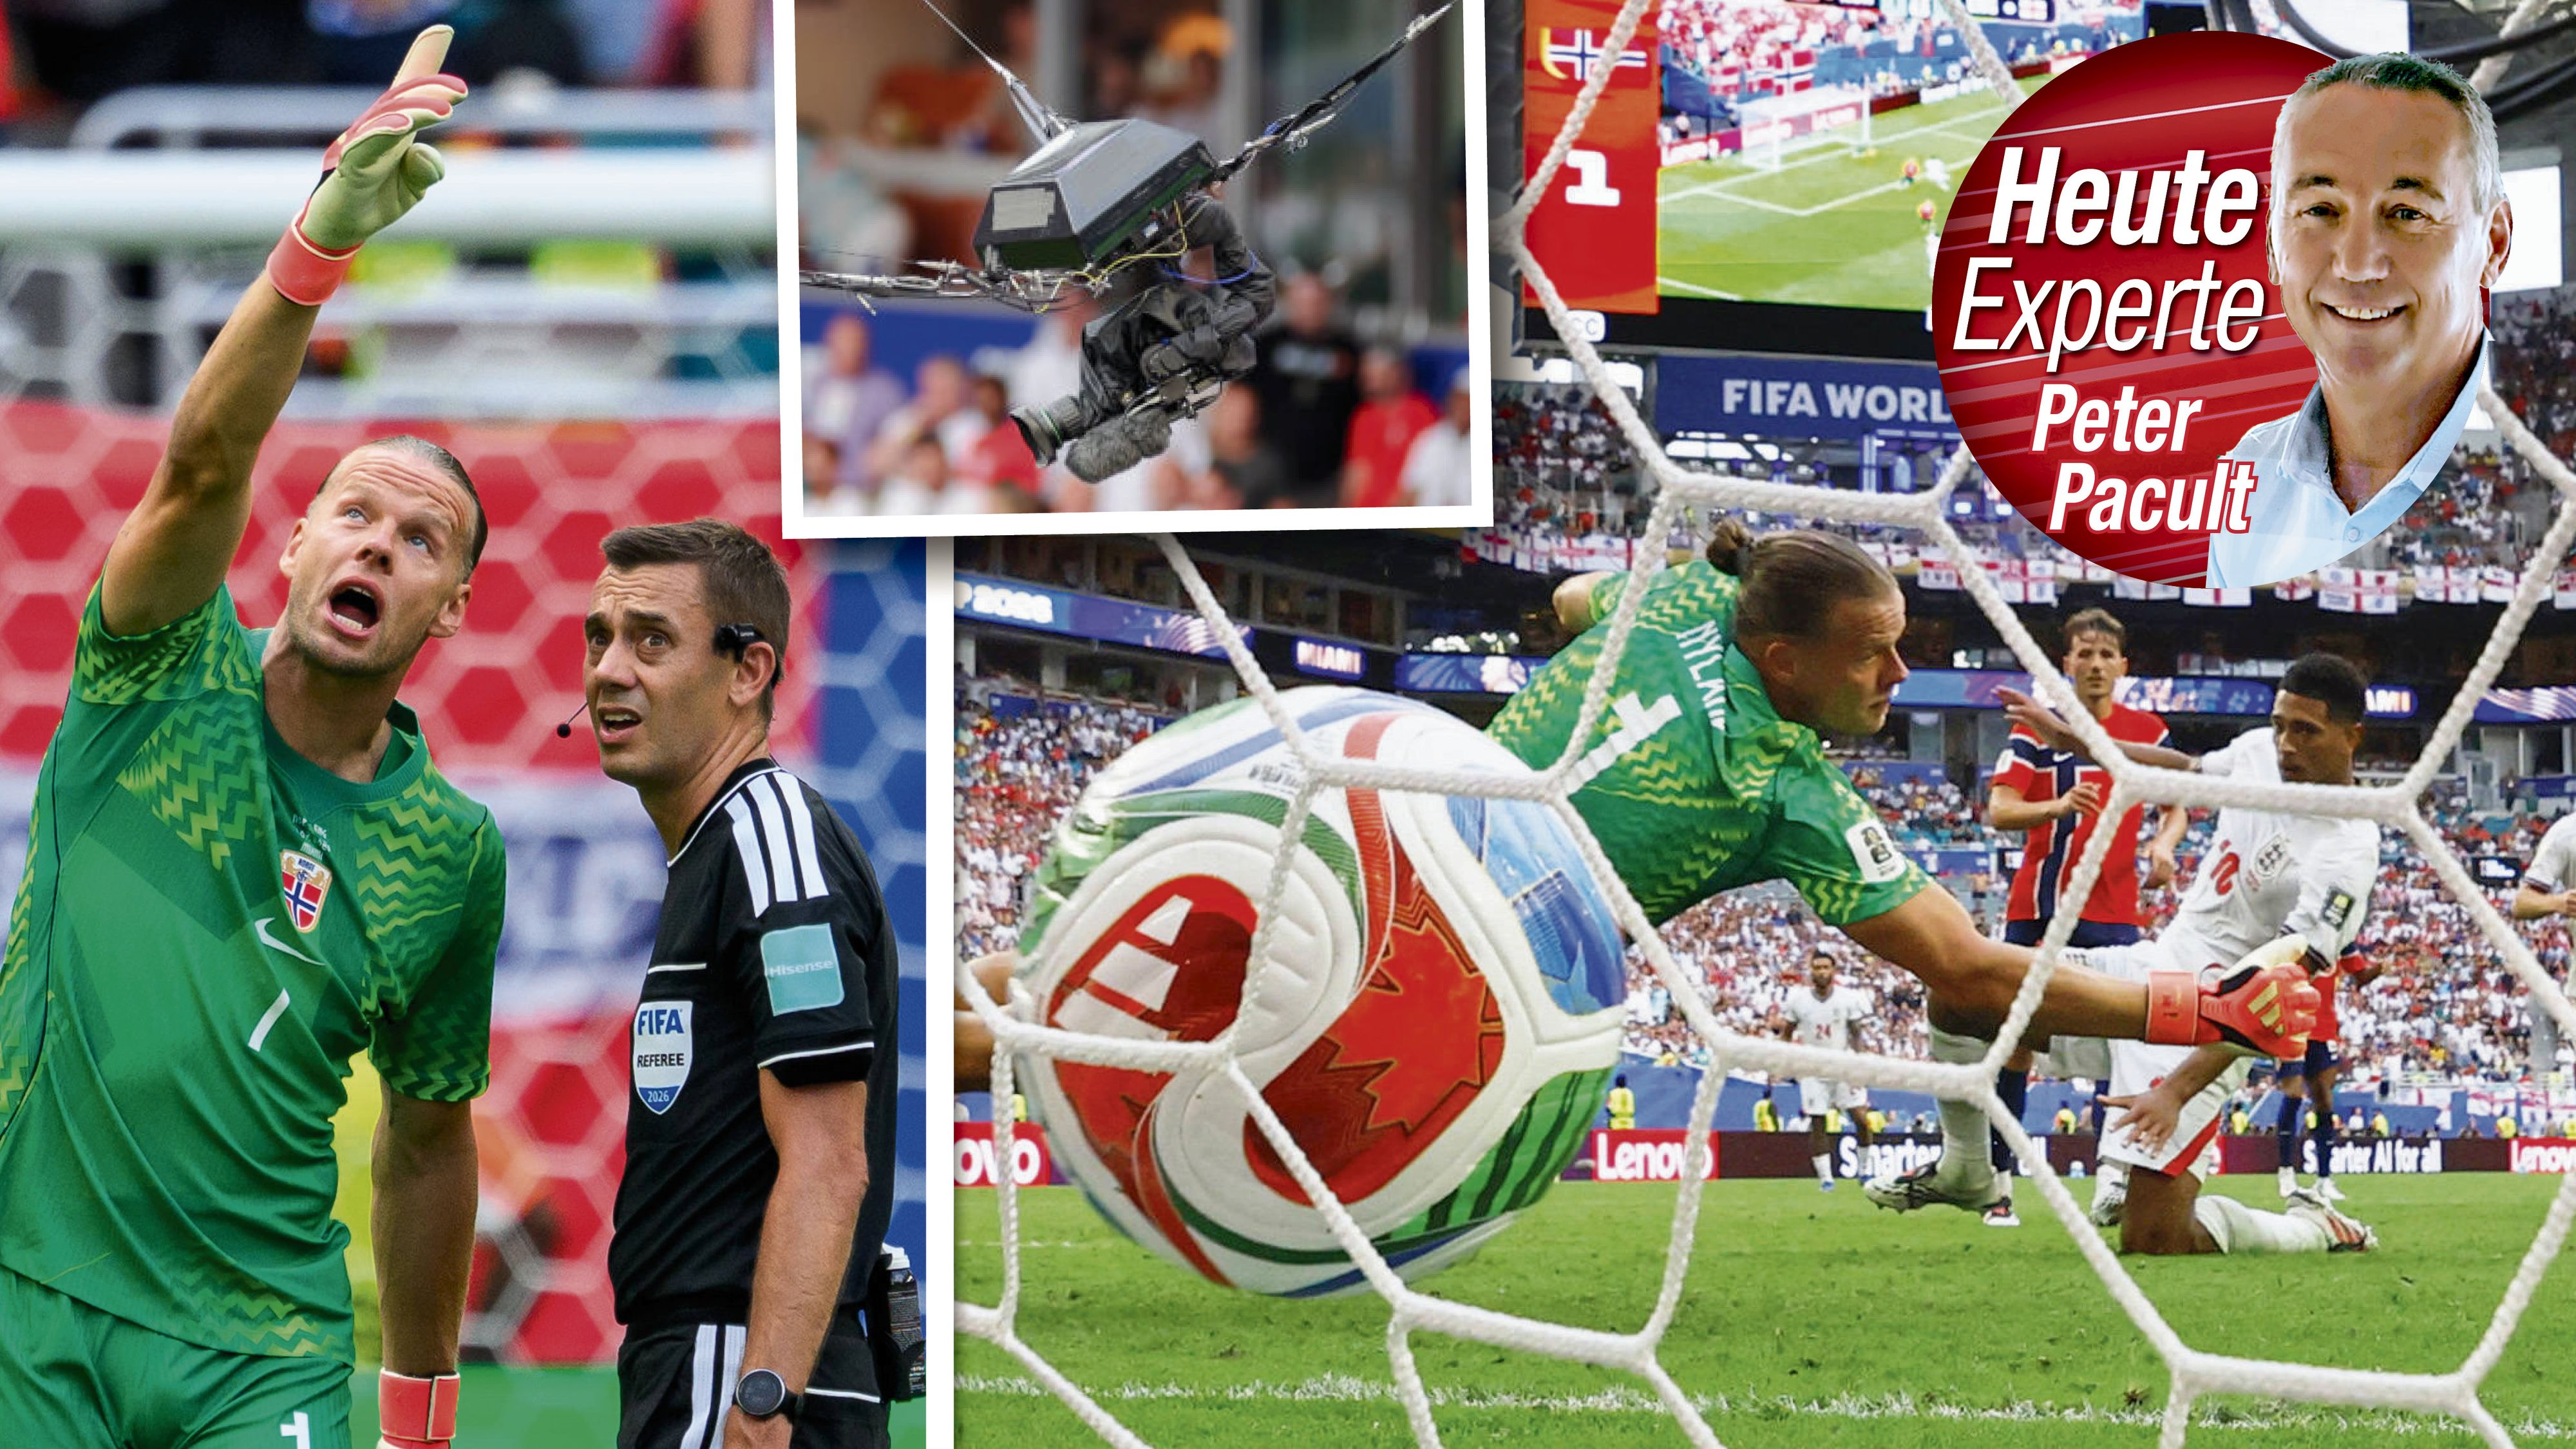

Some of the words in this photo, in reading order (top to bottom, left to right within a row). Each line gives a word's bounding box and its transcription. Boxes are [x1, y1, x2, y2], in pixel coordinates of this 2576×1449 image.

[1566, 149, 1620, 206] 1
[1723, 379, 1819, 417] FIFA
[1824, 383, 1953, 424] WORL
[1296, 640, 1361, 674] MIAMI
[1562, 691, 1683, 799] 1
[769, 960, 834, 976] Hisense
[638, 1009, 685, 1036] FIFA
[637, 1052, 685, 1068] REFEREE
[647, 1090, 670, 1103] 2026
[2302, 1139, 2372, 1173] Sarter
[2372, 1139, 2393, 1173] AI
[2394, 1139, 2420, 1173] for
[2421, 1139, 2443, 1172] all
